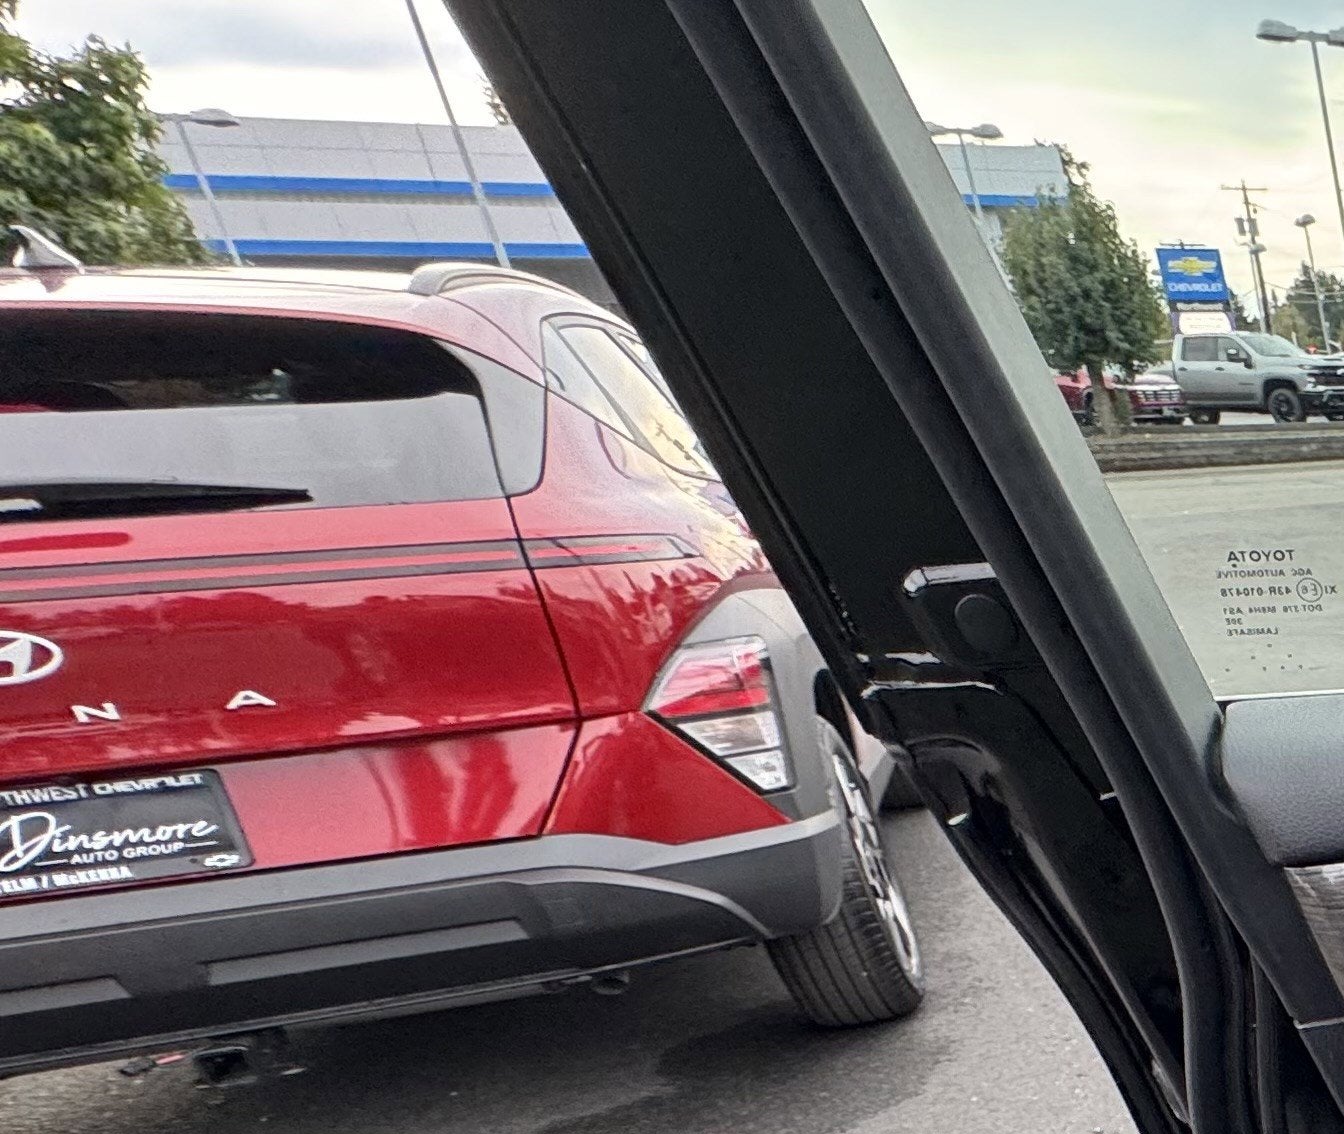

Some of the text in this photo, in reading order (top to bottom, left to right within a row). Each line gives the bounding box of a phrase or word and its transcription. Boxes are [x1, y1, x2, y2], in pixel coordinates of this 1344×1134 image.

[92, 773, 204, 795] CHEVROLET
[0, 811, 220, 873] Dinsmore
[70, 843, 187, 866] AUTO GROUP
